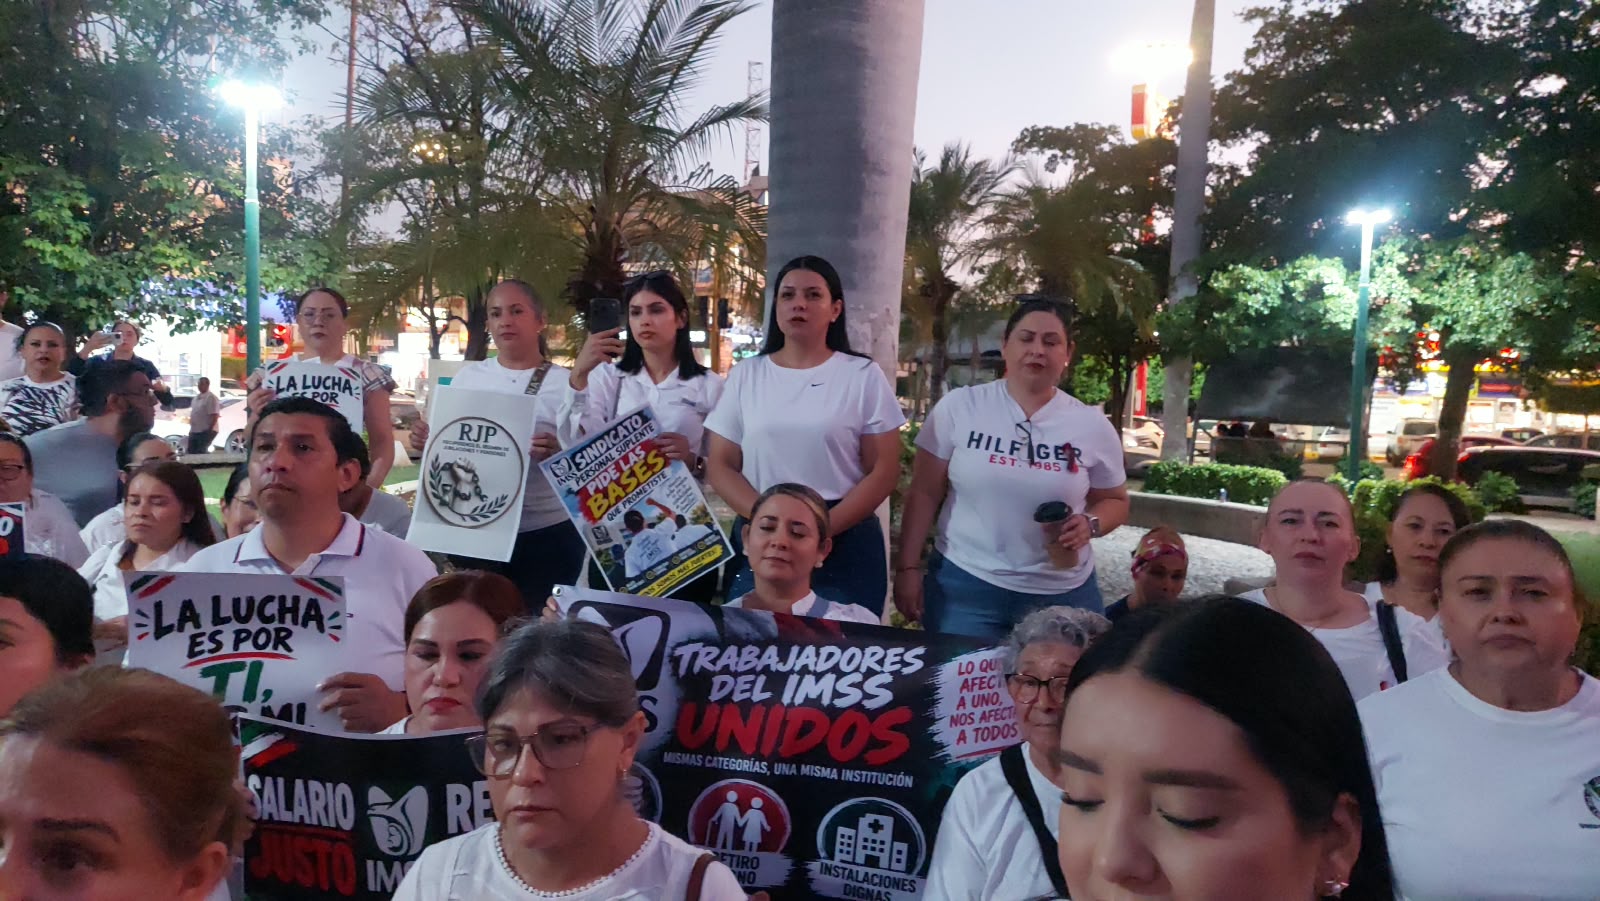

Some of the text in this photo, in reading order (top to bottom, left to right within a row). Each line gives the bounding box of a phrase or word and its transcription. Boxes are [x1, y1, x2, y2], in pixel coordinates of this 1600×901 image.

[275, 374, 353, 396] LA LUCHA
[312, 392, 340, 404] POR
[459, 422, 497, 443] RJP
[574, 414, 642, 467] SINDICATO
[575, 422, 655, 486] PERSONAL SUPLENTE
[586, 445, 646, 496] PIDE LAS
[988, 454, 1022, 468] EST.
[586, 449, 666, 519] BASES
[606, 507, 622, 522] QUE
[622, 470, 669, 509] PROMETISTE
[153, 594, 325, 641] LA LUCHA
[186, 626, 294, 659] ES POR
[673, 641, 928, 675] TRABAJADORES
[199, 660, 273, 704] TI,
[958, 658, 1001, 676] LO QU
[709, 672, 895, 711] DEL IMSS
[956, 691, 1003, 711] A UNO,
[677, 702, 913, 766] UNIDOS
[949, 706, 1017, 728] NOS AFECT
[956, 722, 1018, 746] A TODOS
[663, 751, 914, 788] MISMAS CATEGORÍAS, UNA MISMA INSTITUCIÓN
[247, 774, 356, 831] SALARIO
[252, 830, 357, 897] JUSTO
[713, 851, 760, 871] ETIRO
[819, 861, 917, 893] INSTALACIONES
[843, 883, 893, 901] DIGNAS
